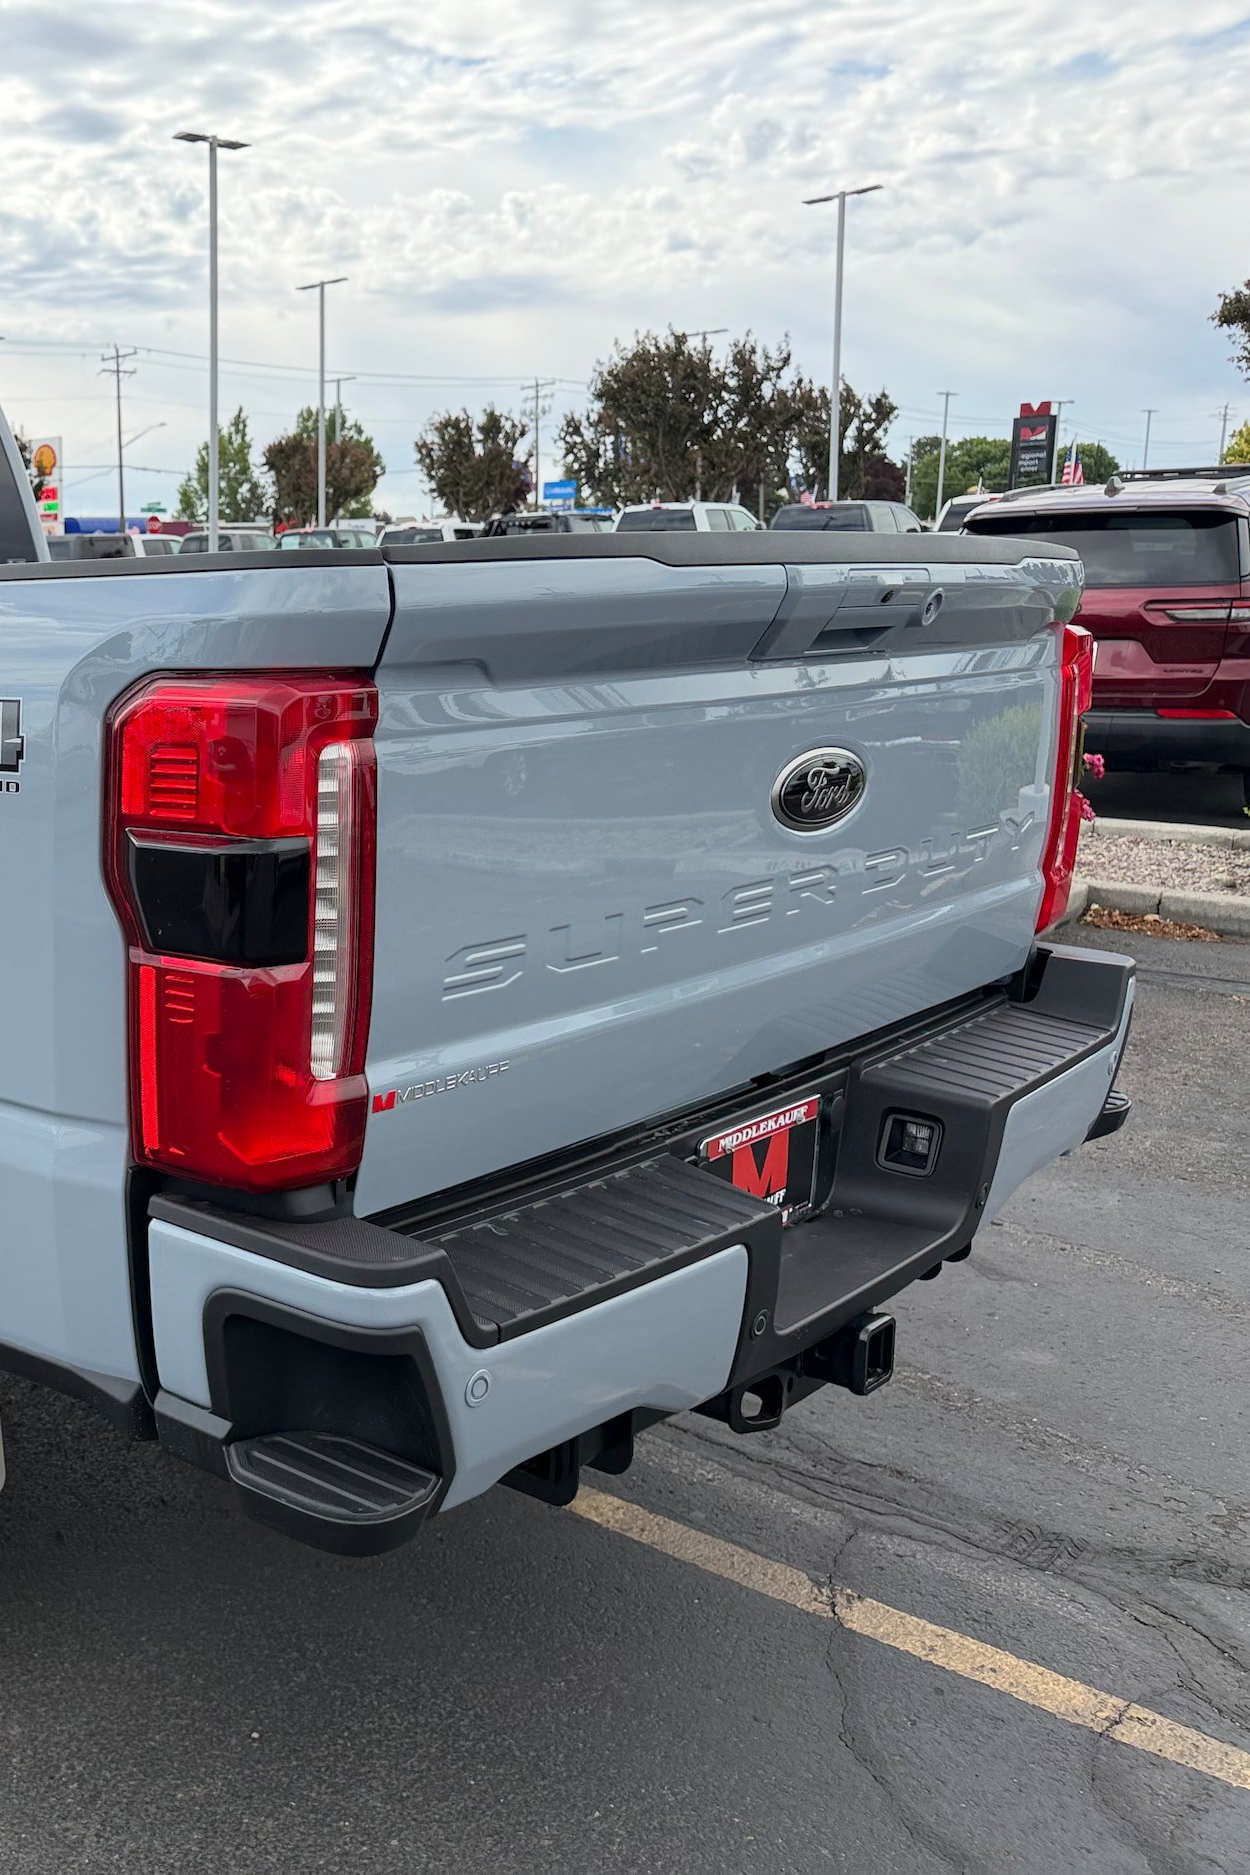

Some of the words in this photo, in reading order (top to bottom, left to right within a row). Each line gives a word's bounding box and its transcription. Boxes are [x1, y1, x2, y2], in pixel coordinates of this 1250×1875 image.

[800, 766, 853, 814] Ford
[441, 864, 838, 1001] SUPER
[861, 811, 1036, 896] DUTY
[396, 1060, 510, 1105] MIDDLEKAUFF
[717, 1105, 809, 1152] MIDDLEKAUFF
[731, 1128, 790, 1199] M
